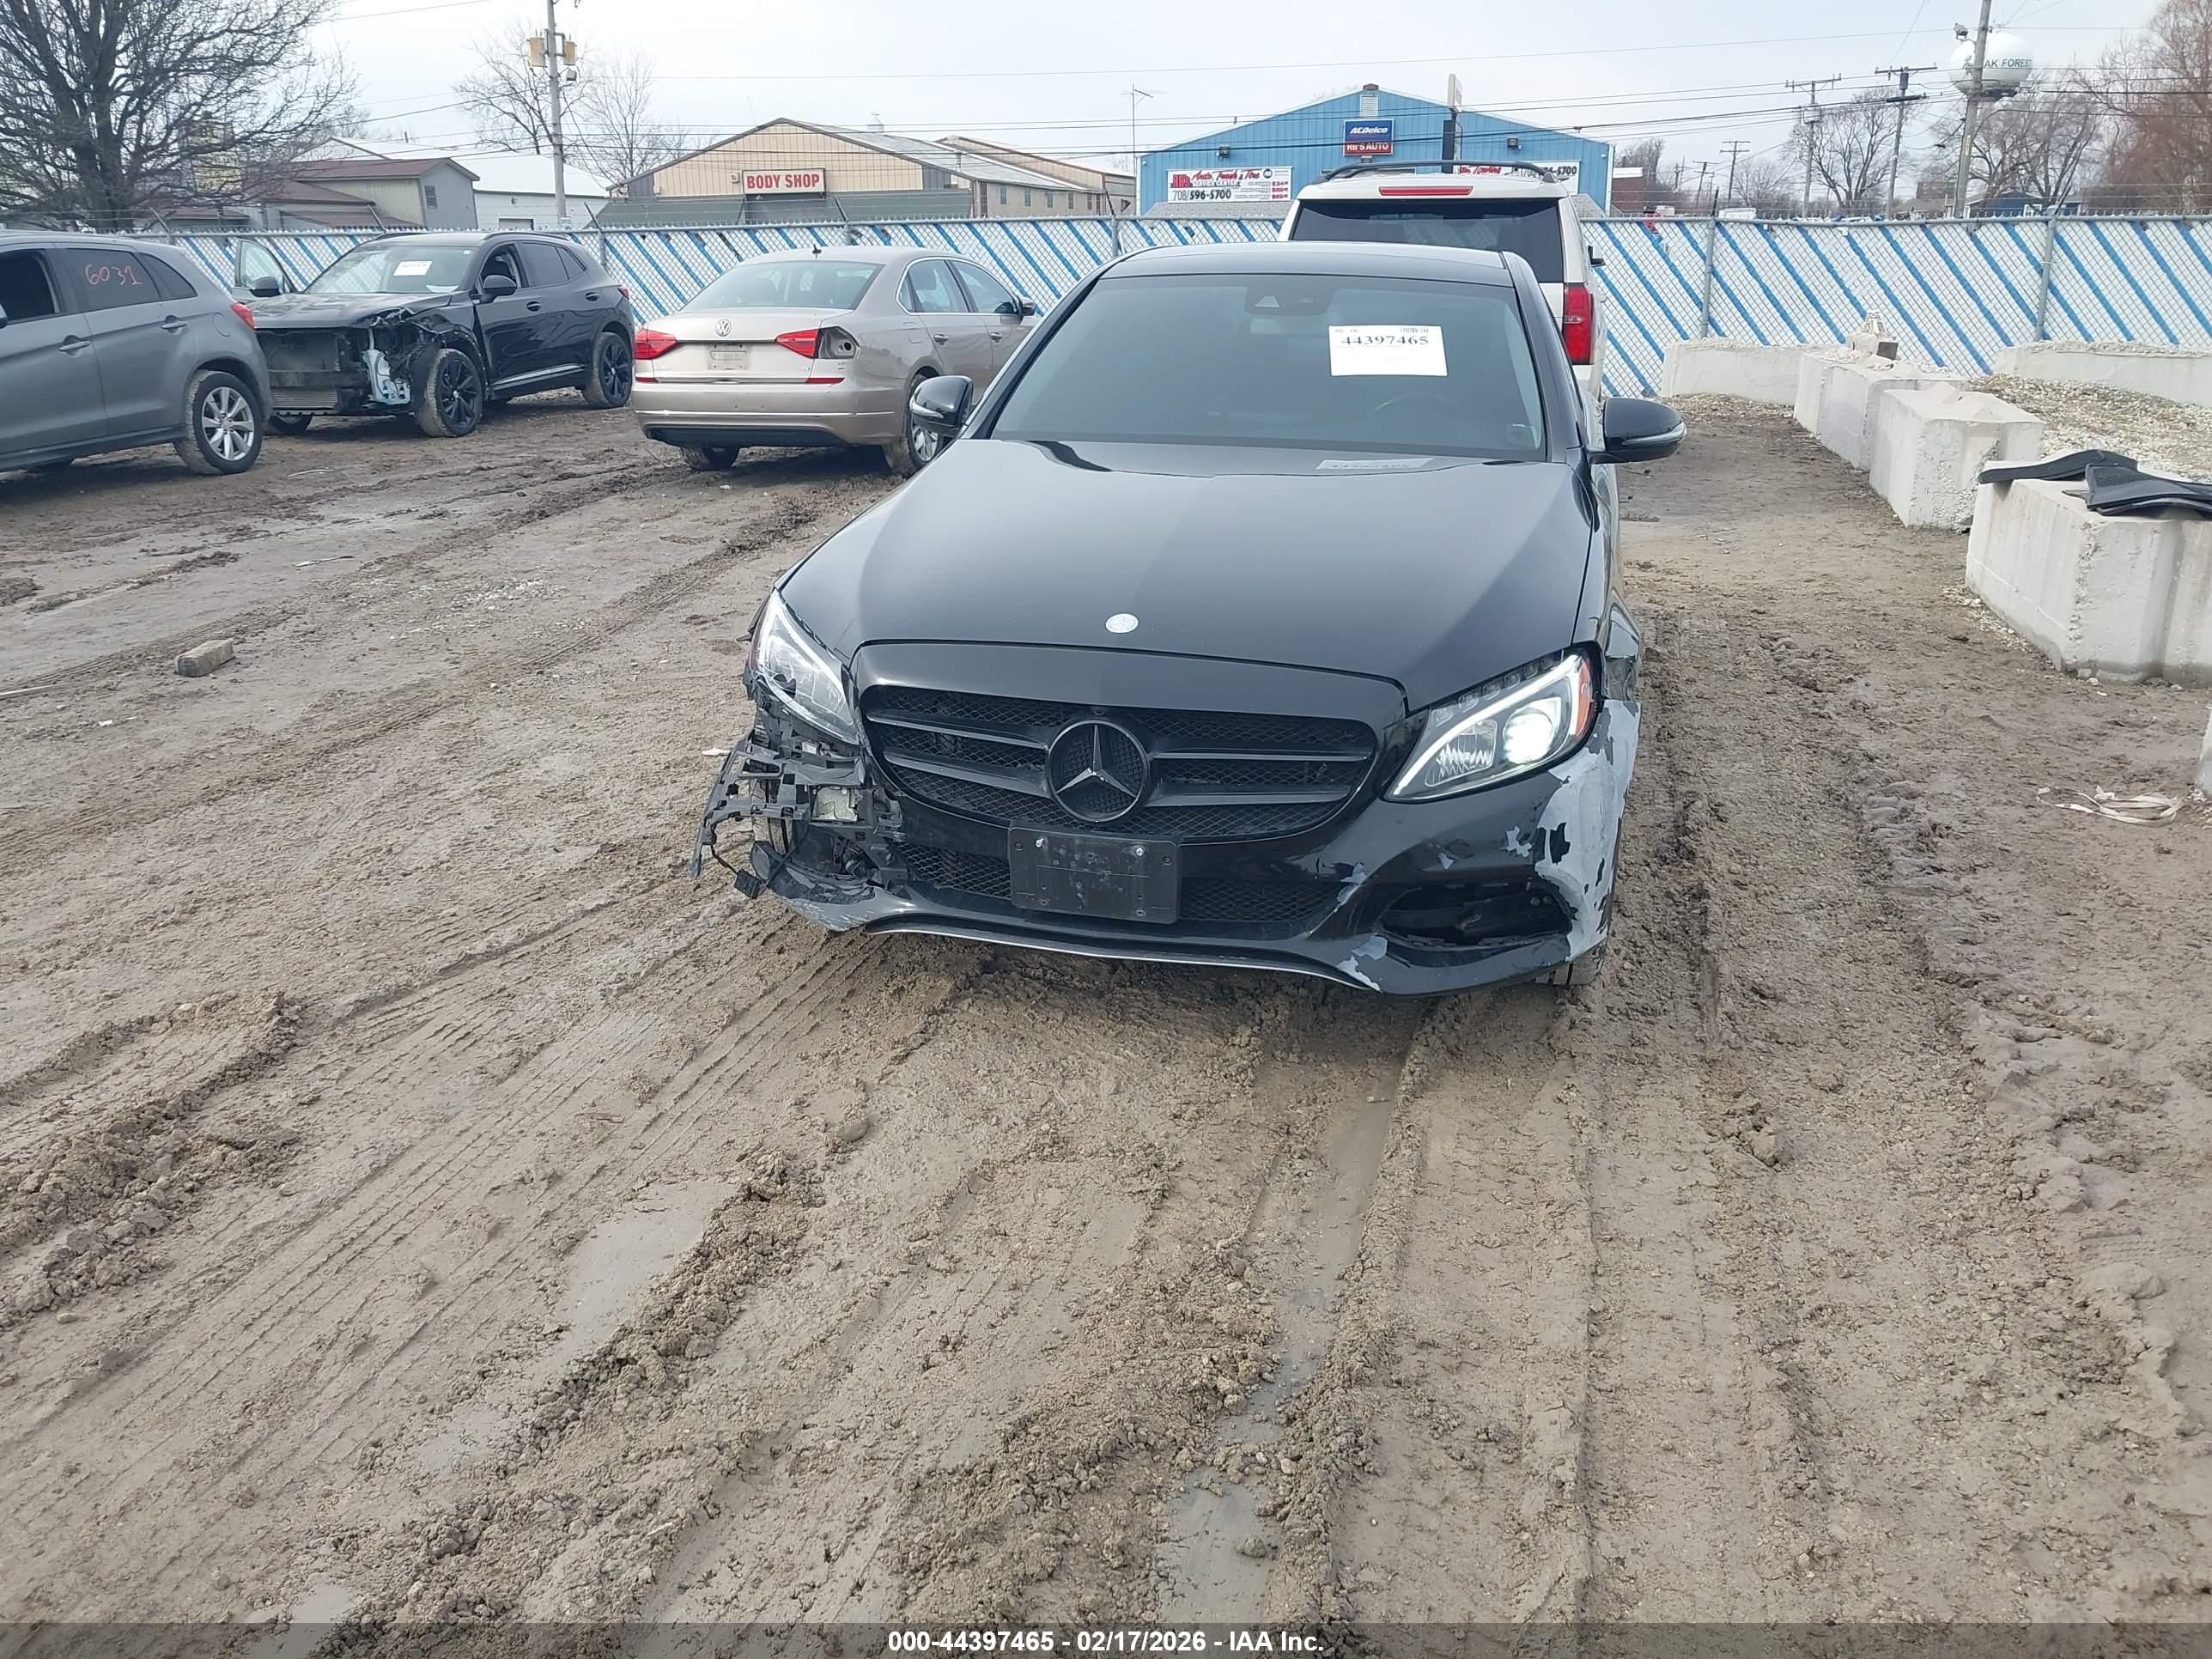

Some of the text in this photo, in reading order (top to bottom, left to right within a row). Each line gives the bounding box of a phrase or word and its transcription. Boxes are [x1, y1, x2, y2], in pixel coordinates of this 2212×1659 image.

[2002, 58, 2033, 68] FOREST
[1365, 142, 1389, 150] AUTO
[747, 173, 820, 189] BODY SHOP
[1173, 189, 1231, 201] 708/596-5700
[85, 264, 143, 285] 6031
[1341, 336, 1429, 345] 44397465
